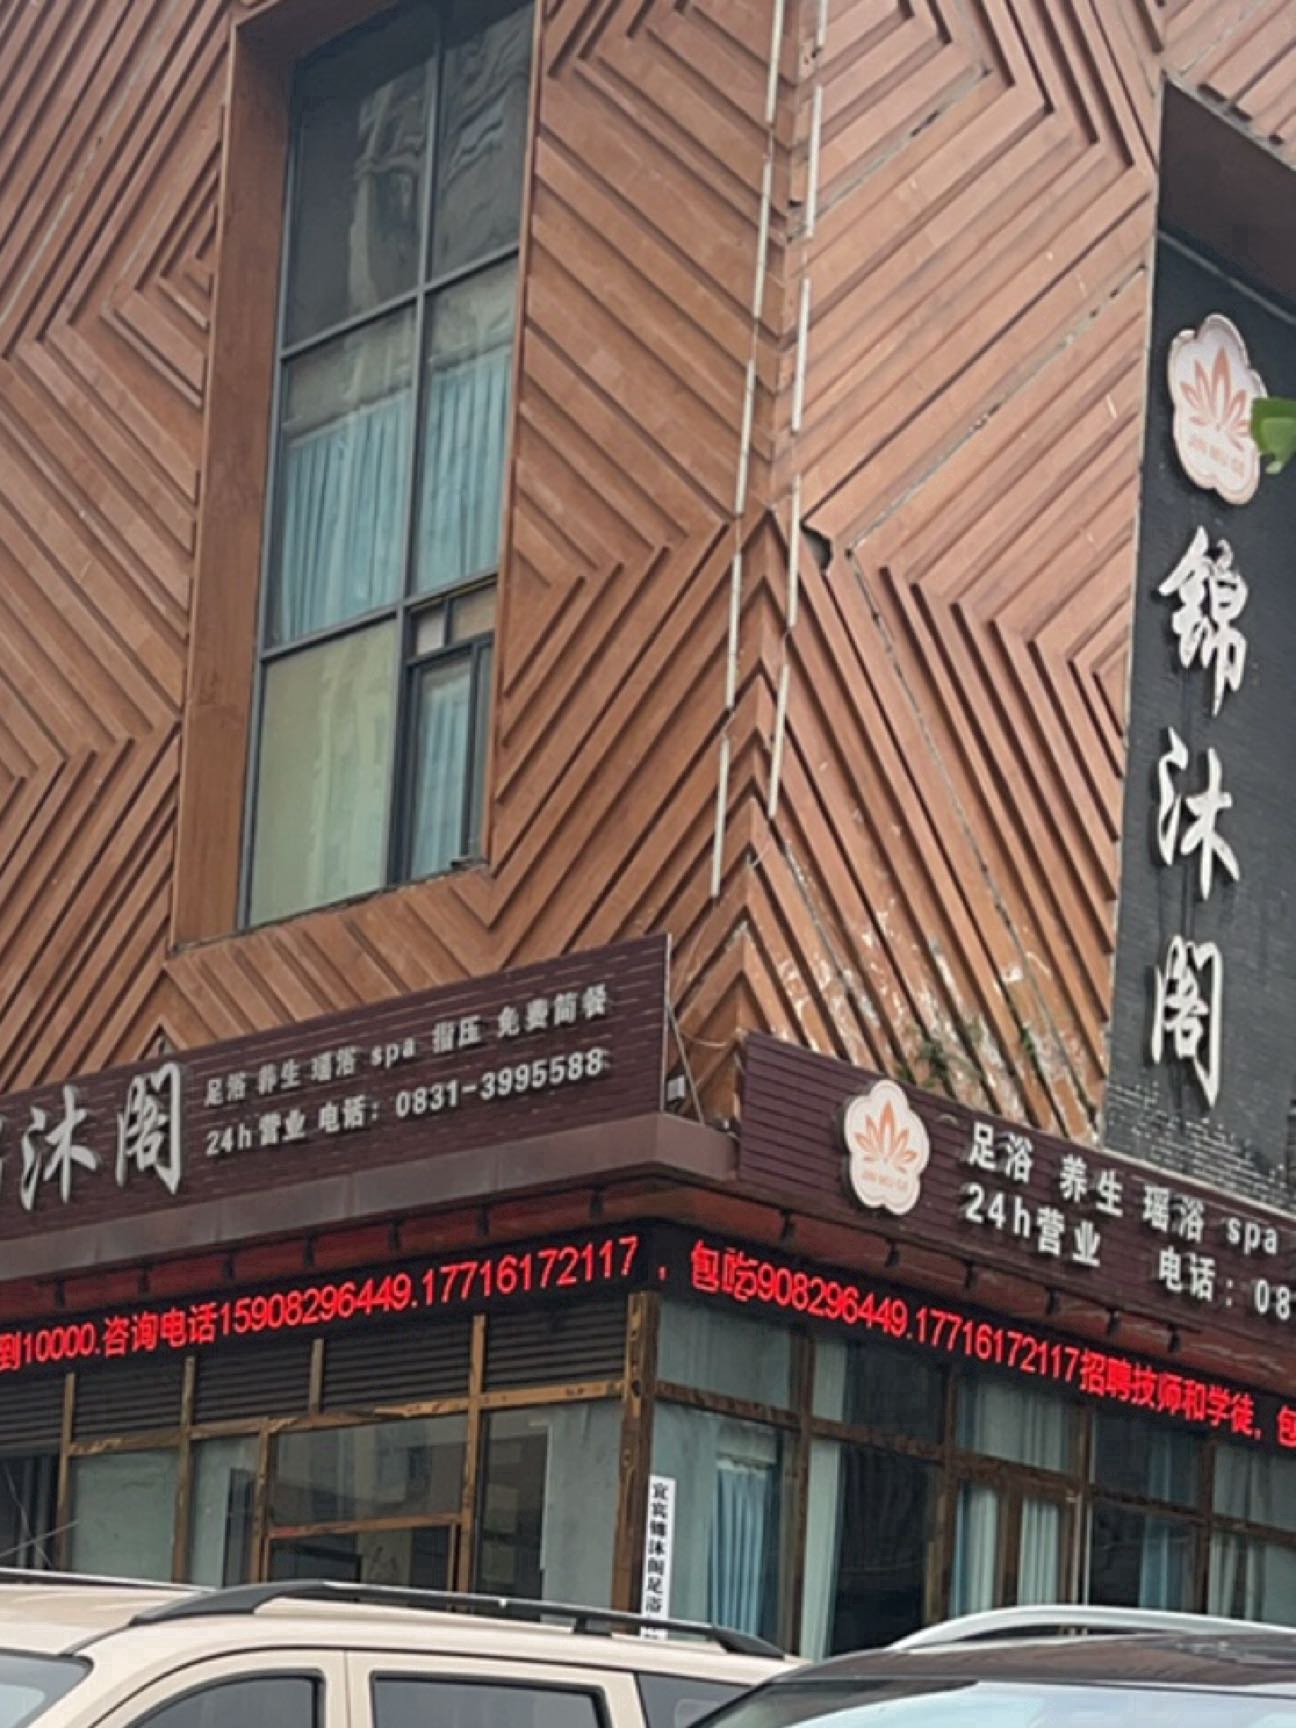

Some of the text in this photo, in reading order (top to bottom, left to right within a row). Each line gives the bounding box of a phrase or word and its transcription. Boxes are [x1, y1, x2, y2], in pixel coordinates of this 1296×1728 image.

[205, 1074, 247, 1107] 足浴
[370, 1037, 418, 1068] spa
[968, 1121, 1034, 1184] 足浴
[1059, 1154, 1124, 1218] 养生
[1226, 1217, 1278, 1255] spa
